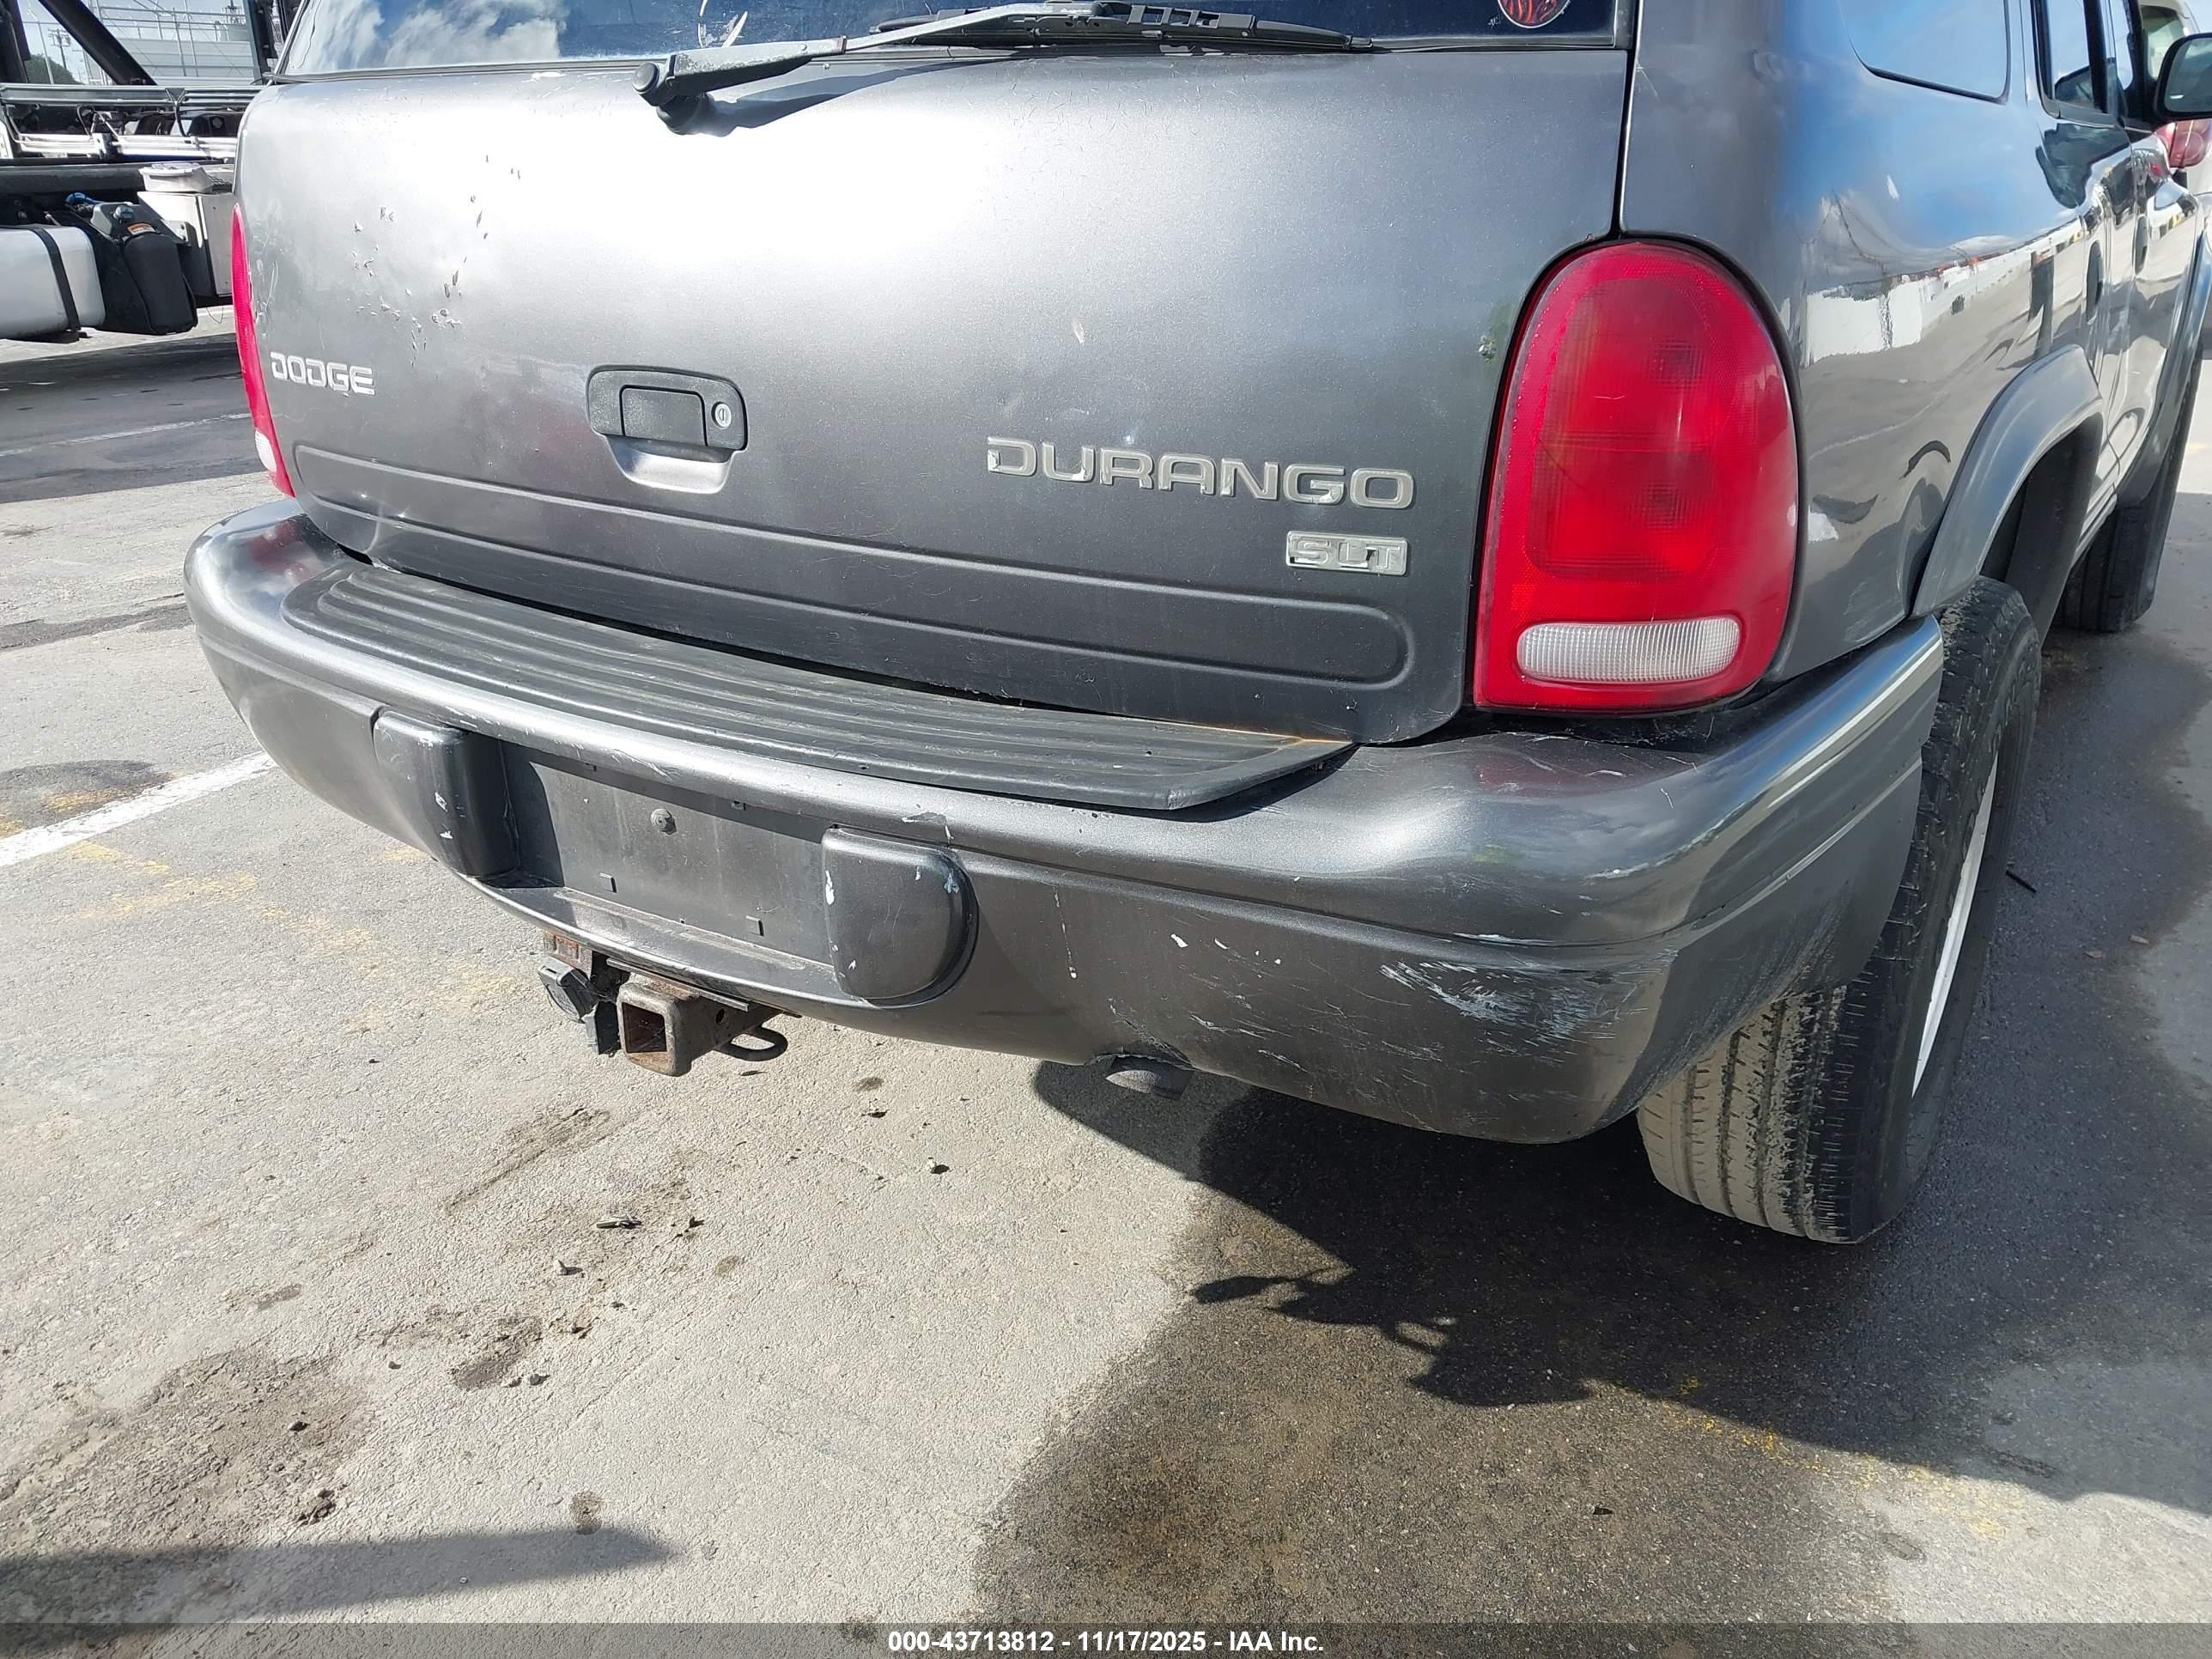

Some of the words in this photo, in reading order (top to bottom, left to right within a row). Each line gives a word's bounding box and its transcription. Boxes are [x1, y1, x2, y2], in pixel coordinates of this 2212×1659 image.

[270, 351, 375, 395] DODGE
[988, 436, 1414, 508] DURANGO
[1291, 538, 1401, 569] SLT
